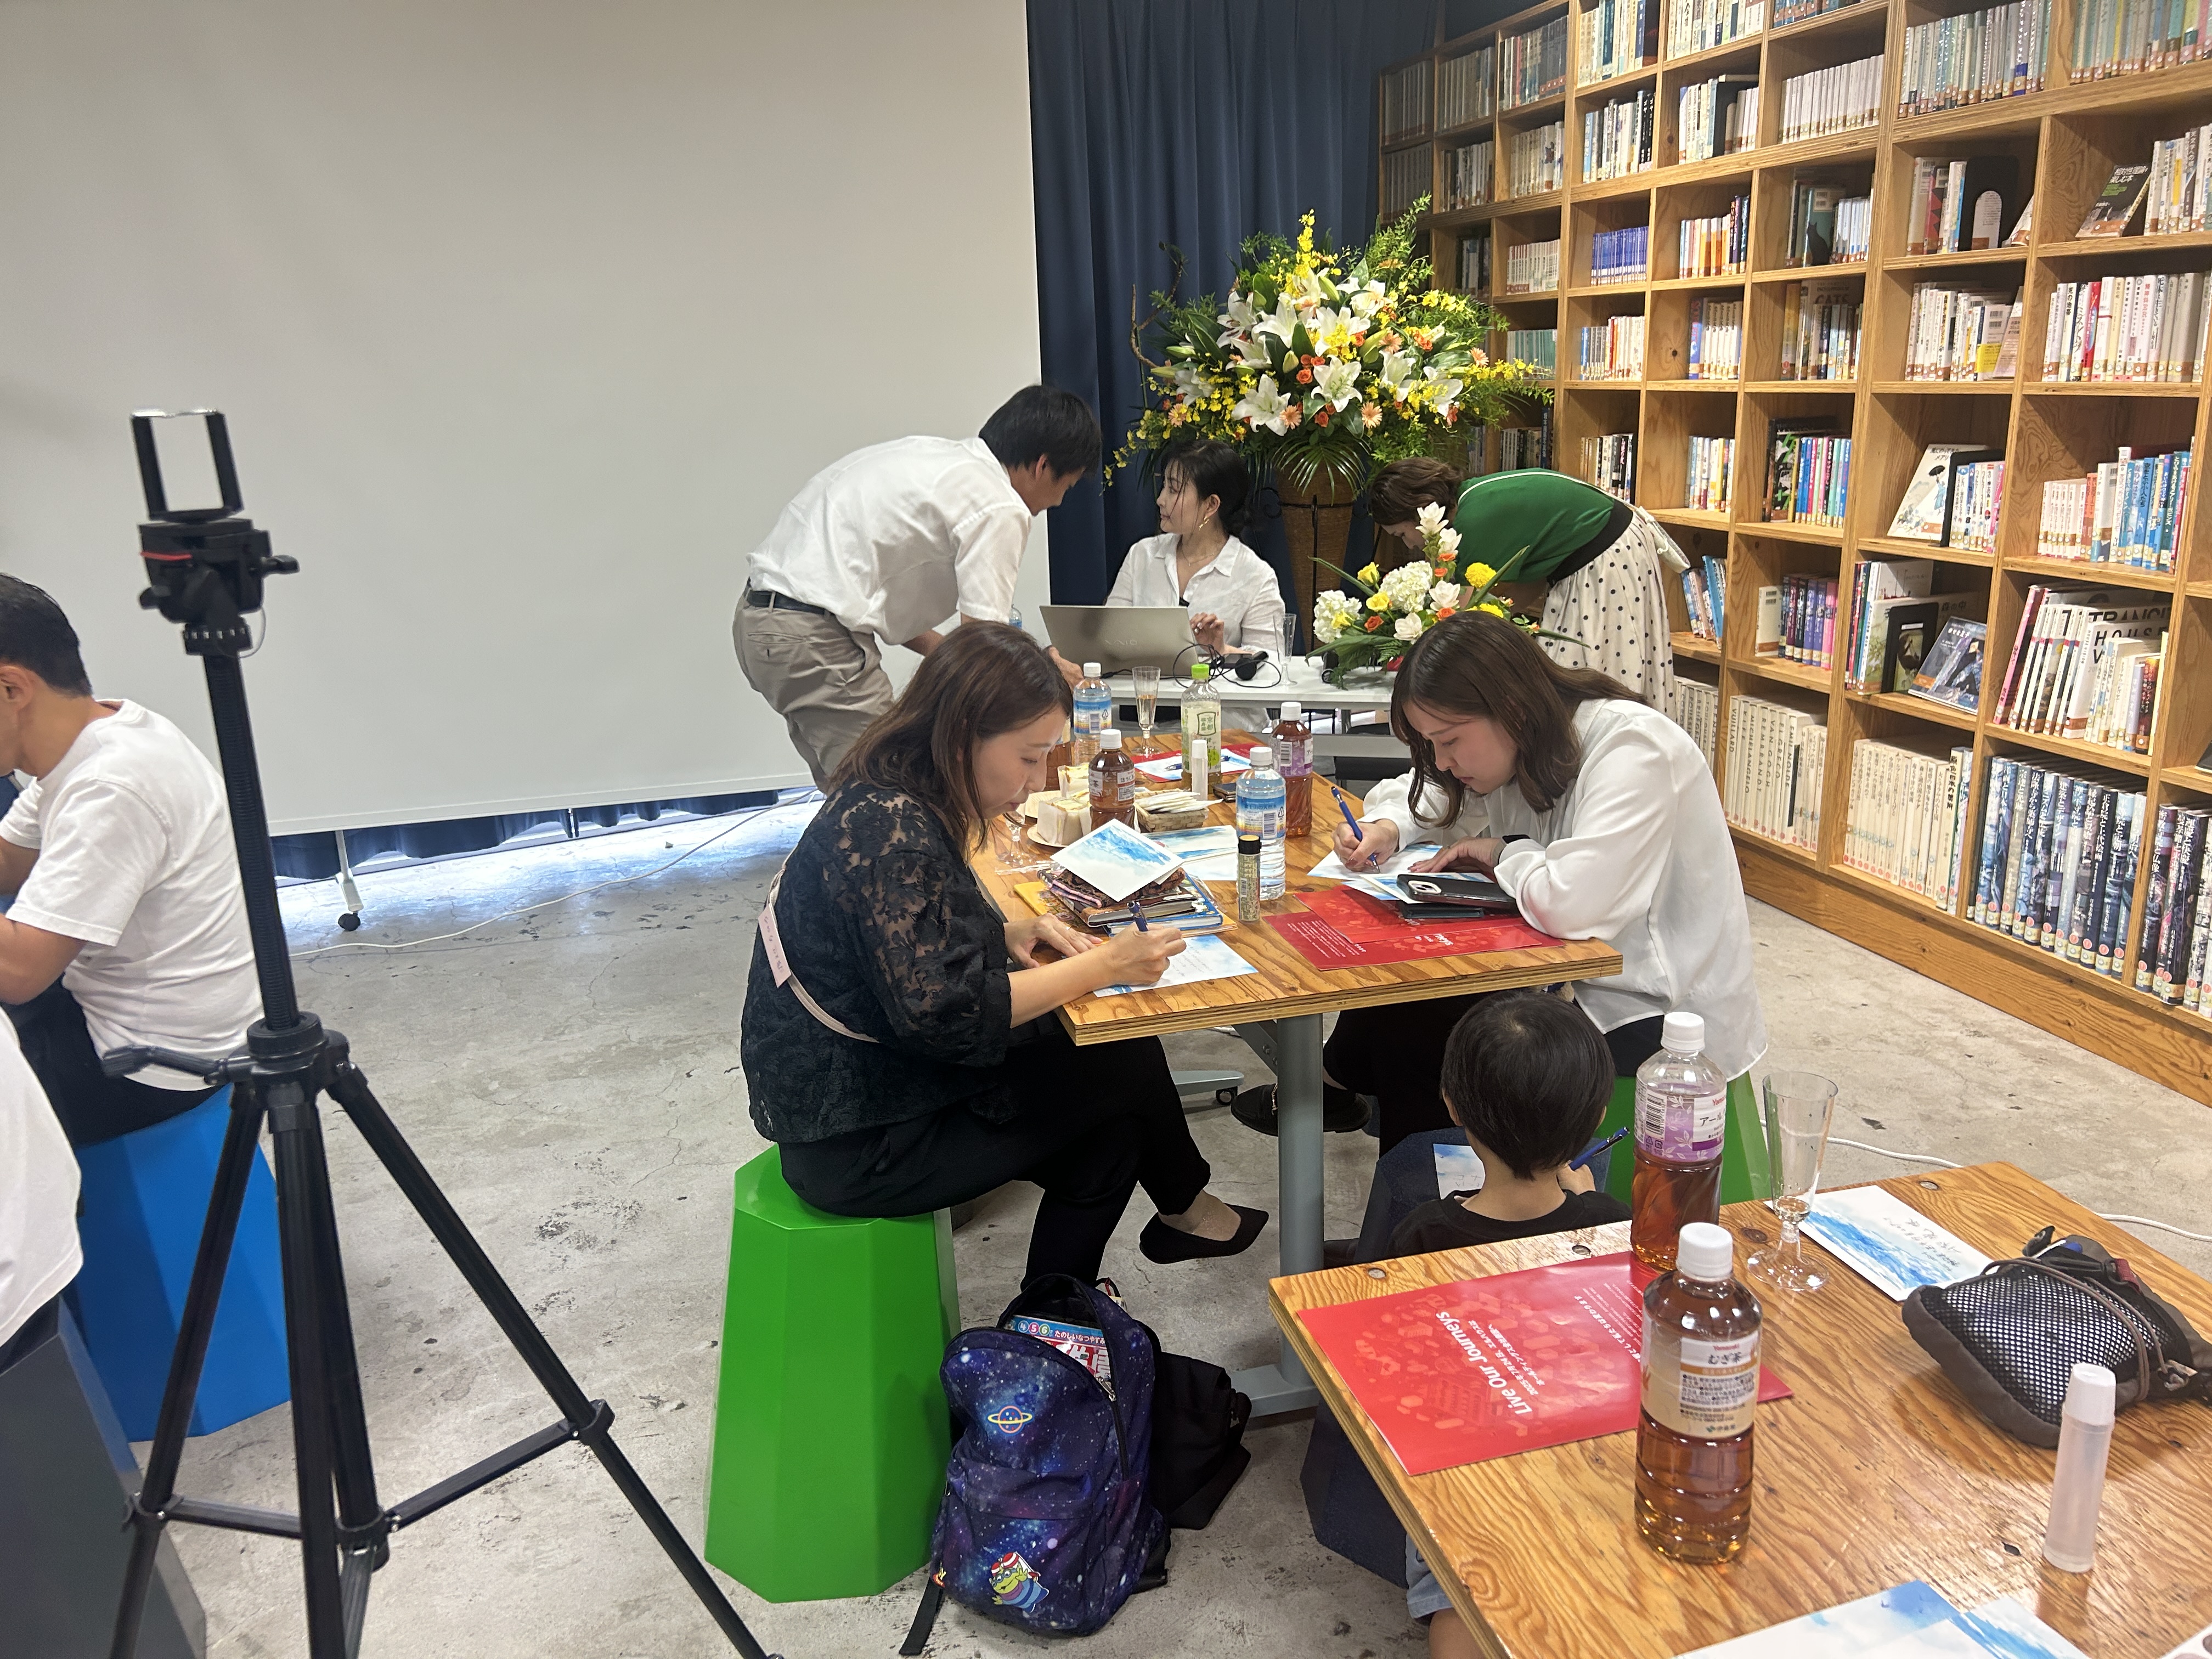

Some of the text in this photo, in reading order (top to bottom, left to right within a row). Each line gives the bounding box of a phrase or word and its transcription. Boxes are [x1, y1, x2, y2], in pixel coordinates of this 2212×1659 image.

[1729, 708, 1737, 752] VUILLARD
[1745, 715, 1754, 793] MICHELANGELO
[1757, 718, 1767, 792] REMBRANDT
[2055, 781, 2068, 837] 建築とデザイン
[2095, 794, 2111, 862] 正倉院と上代絵画
[2180, 819, 2196, 865] 運慶と快慶
[1700, 1110, 1725, 1126] アール
[1031, 1324, 1037, 1333] 5
[1041, 1325, 1047, 1334] 6
[1054, 1330, 1106, 1344] たのしいなつやすみ
[1436, 1311, 1533, 1414] Live Our Journeys
[1708, 1352, 1742, 1365] むぎ茶
